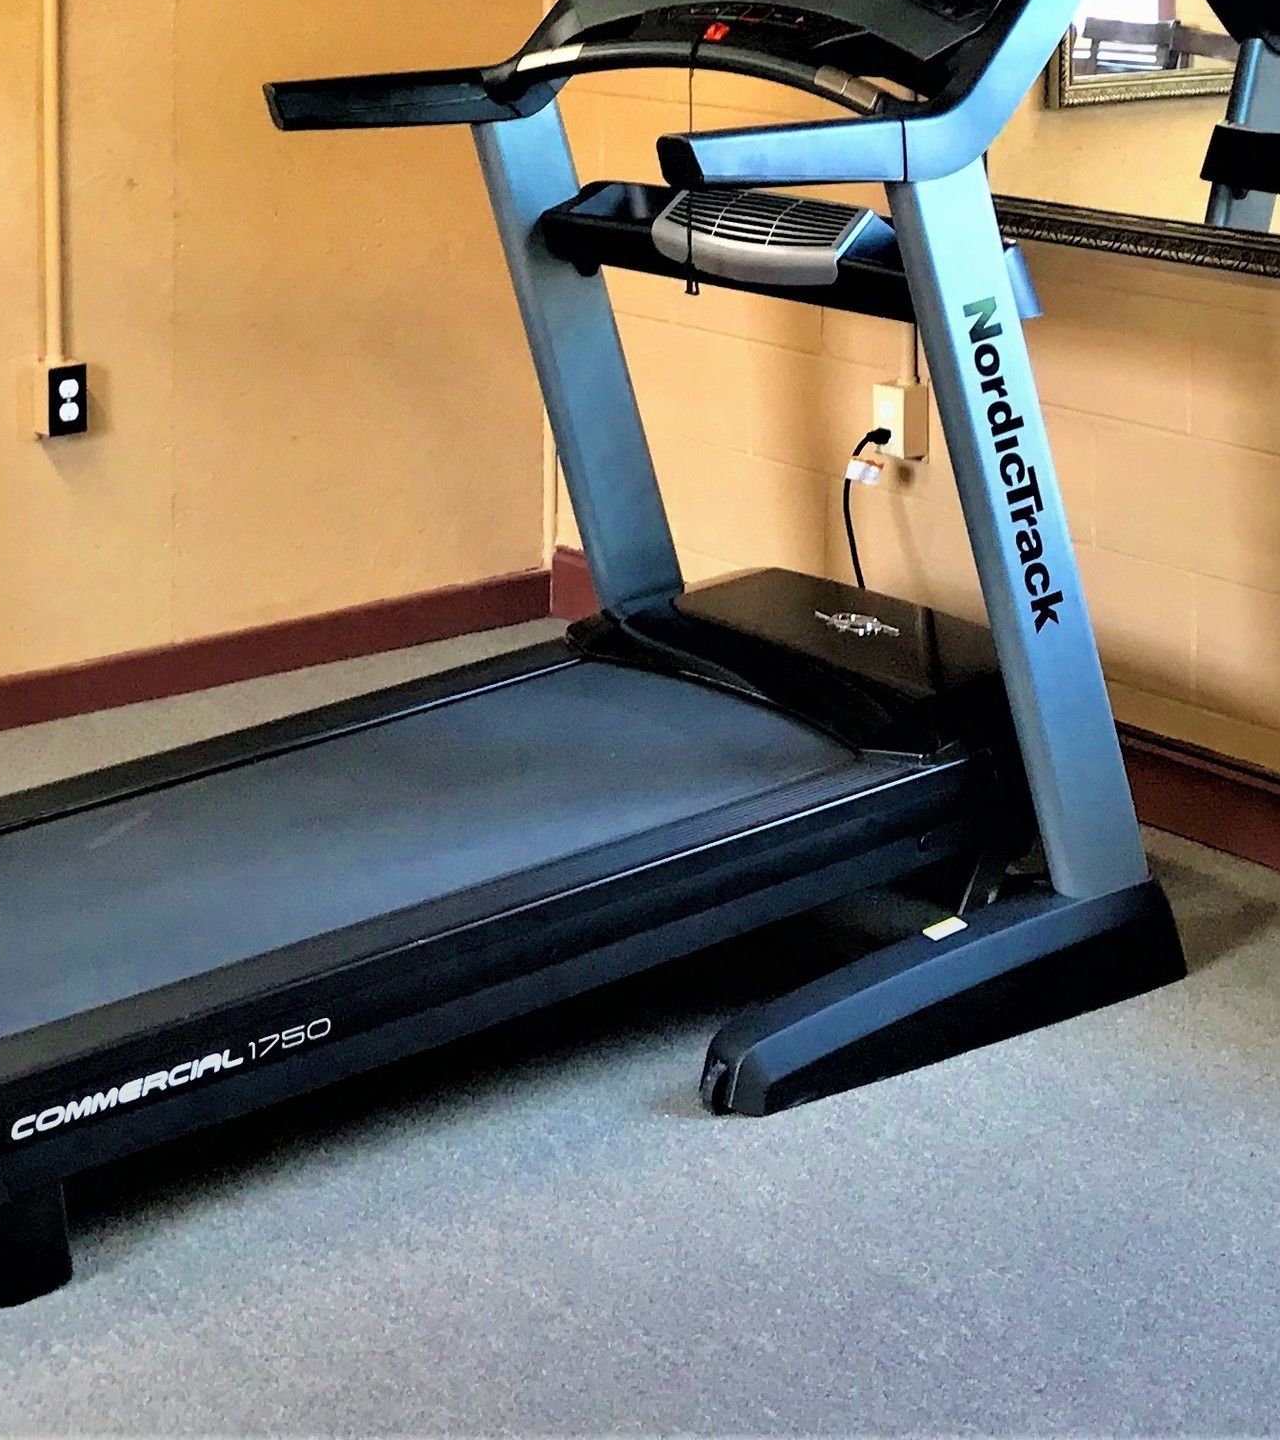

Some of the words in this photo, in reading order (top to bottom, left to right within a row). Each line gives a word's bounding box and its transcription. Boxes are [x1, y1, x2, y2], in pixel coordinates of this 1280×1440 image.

[962, 295, 1064, 634] NordicTrack
[11, 1049, 244, 1141] COMMERCIAL
[248, 1017, 332, 1060] 1750
